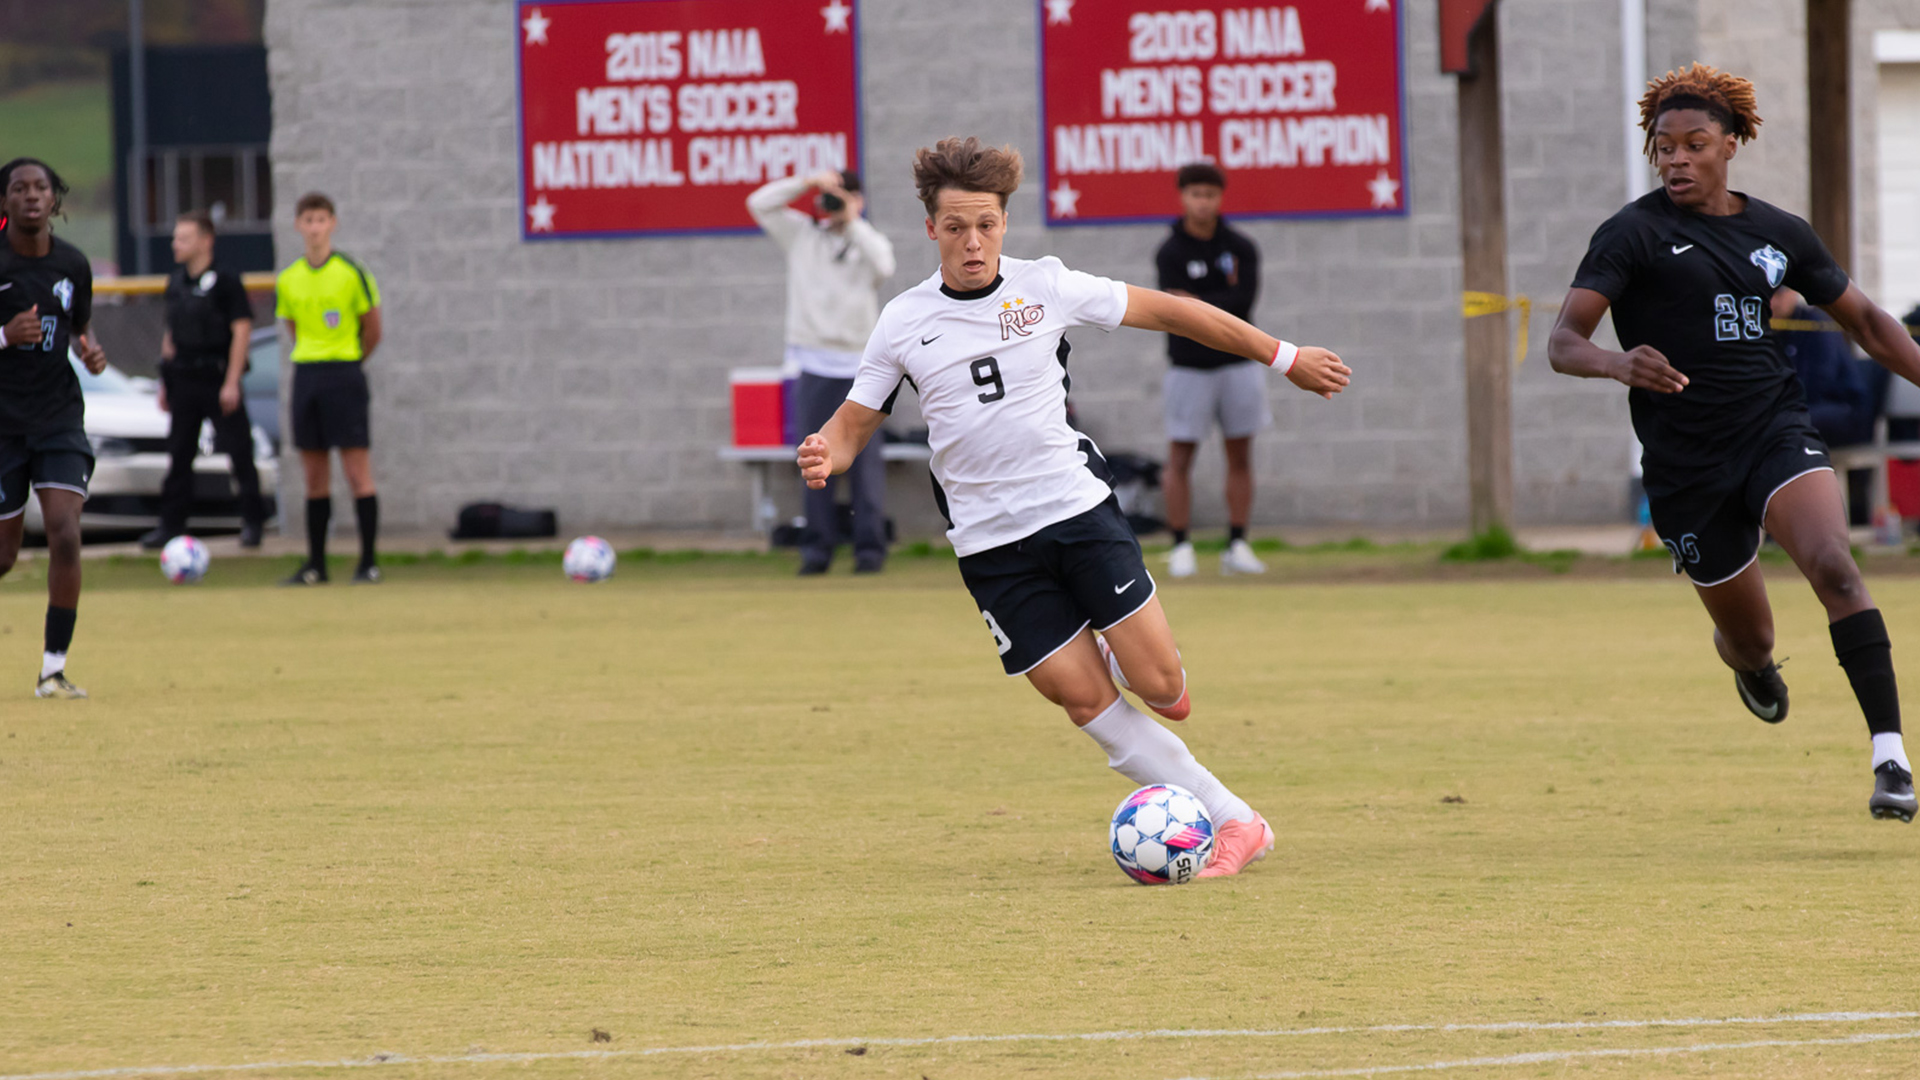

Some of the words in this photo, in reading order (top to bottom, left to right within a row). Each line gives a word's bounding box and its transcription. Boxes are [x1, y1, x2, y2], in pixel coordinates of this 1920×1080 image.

[606, 32, 682, 81] 2015
[688, 29, 765, 77] NAIA
[1129, 12, 1217, 61] 2003
[1222, 7, 1305, 58] NAIA
[577, 87, 672, 135] MEN'S
[678, 81, 798, 132] SOCCER
[1102, 66, 1202, 118] MEN'S
[1209, 61, 1337, 114] SOCCER
[533, 139, 684, 189] NATIONAL
[688, 133, 847, 185] CHAMPION
[1055, 121, 1216, 173] NATIONAL
[1219, 115, 1390, 169] CHAMPION
[998, 304, 1044, 341] RIO
[1714, 293, 1764, 341] 29
[969, 356, 1005, 404] 9
